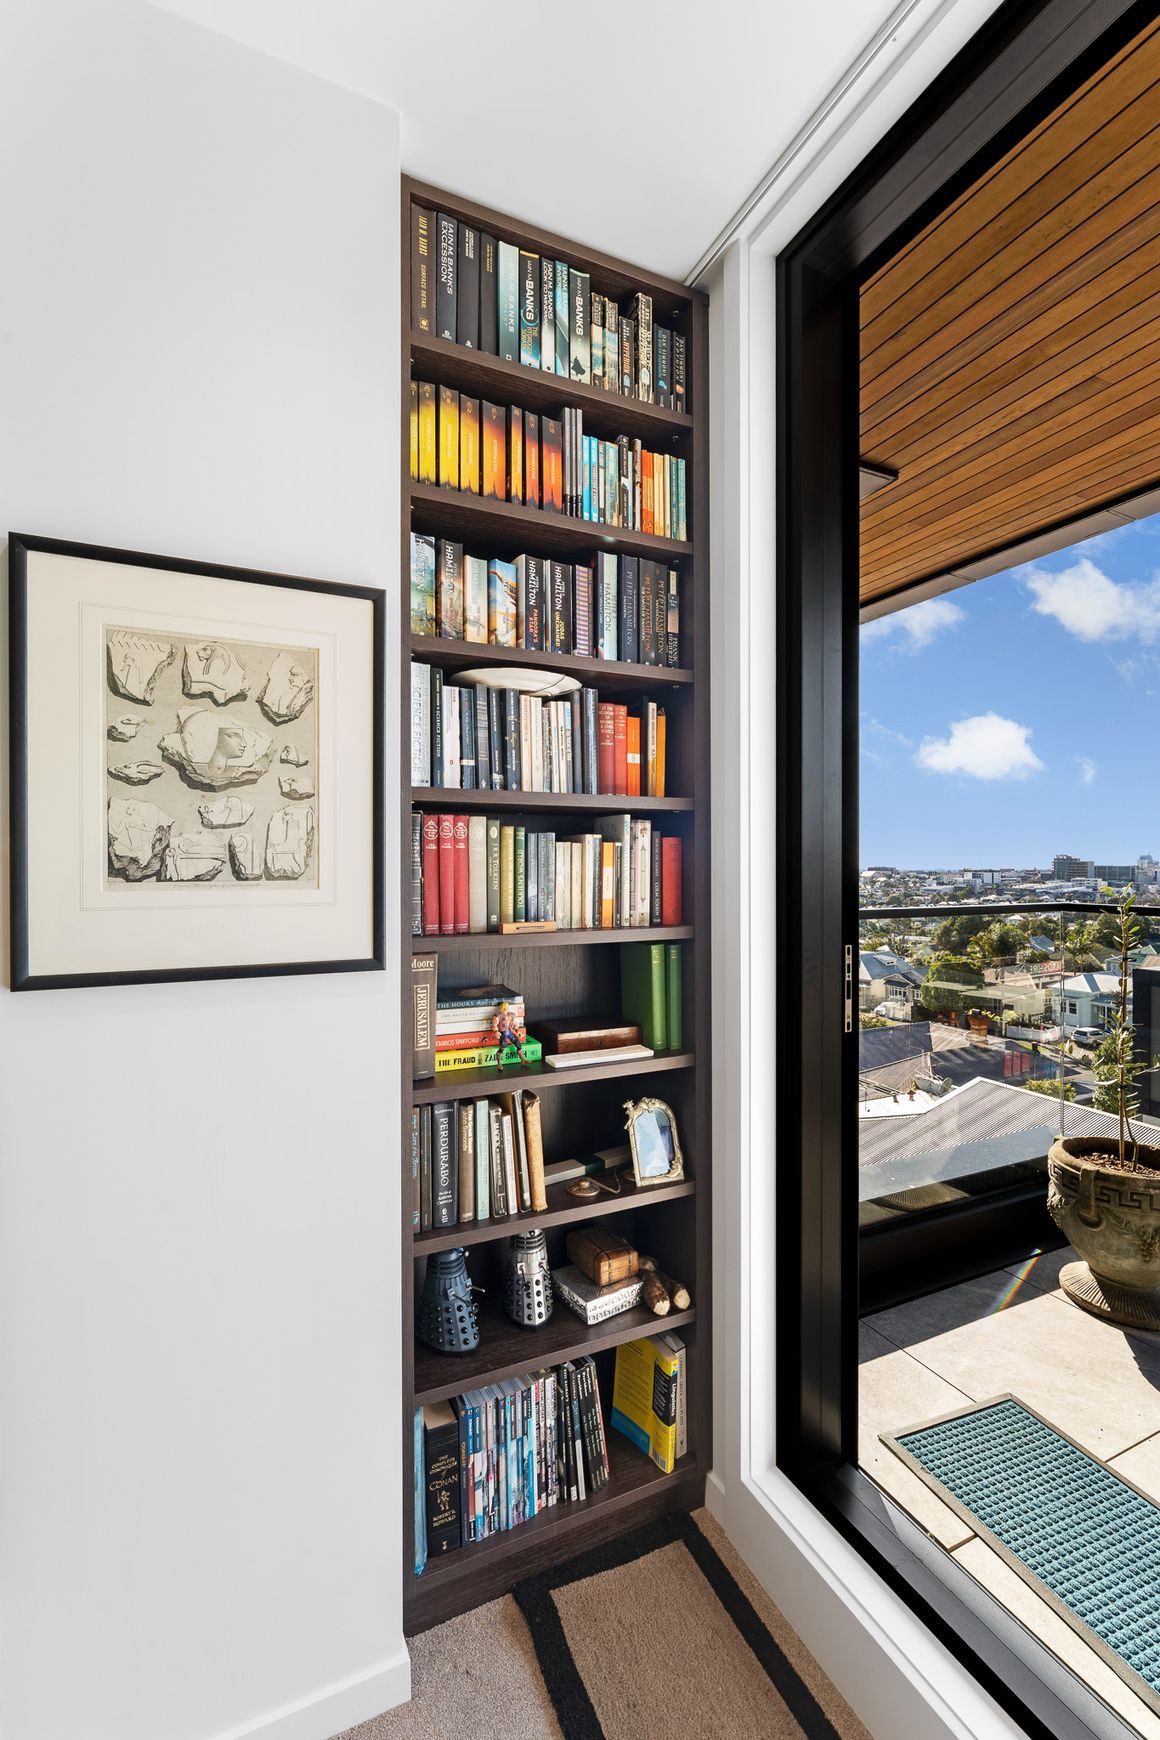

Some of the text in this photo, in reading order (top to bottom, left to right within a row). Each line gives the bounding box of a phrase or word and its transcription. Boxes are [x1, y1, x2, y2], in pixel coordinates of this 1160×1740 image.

[446, 257, 454, 295] BANKS
[543, 283, 548, 293] TO
[525, 280, 534, 321] BANKS
[575, 296, 584, 336] BANKS
[416, 538, 425, 590] HAMILTON
[445, 545, 454, 595] HAMILTON
[529, 560, 537, 606] HAMILTON
[554, 565, 562, 610] HAMILTON
[412, 687, 422, 773] SCIENCE FICTION
[416, 987, 427, 1047] JERUSALEM
[451, 1000, 474, 1008] HOURS
[438, 1059, 451, 1067] THE
[453, 1056, 476, 1065] FRAUD
[440, 1117, 449, 1187] PERDURABO
[429, 1473, 459, 1491] CONAN
